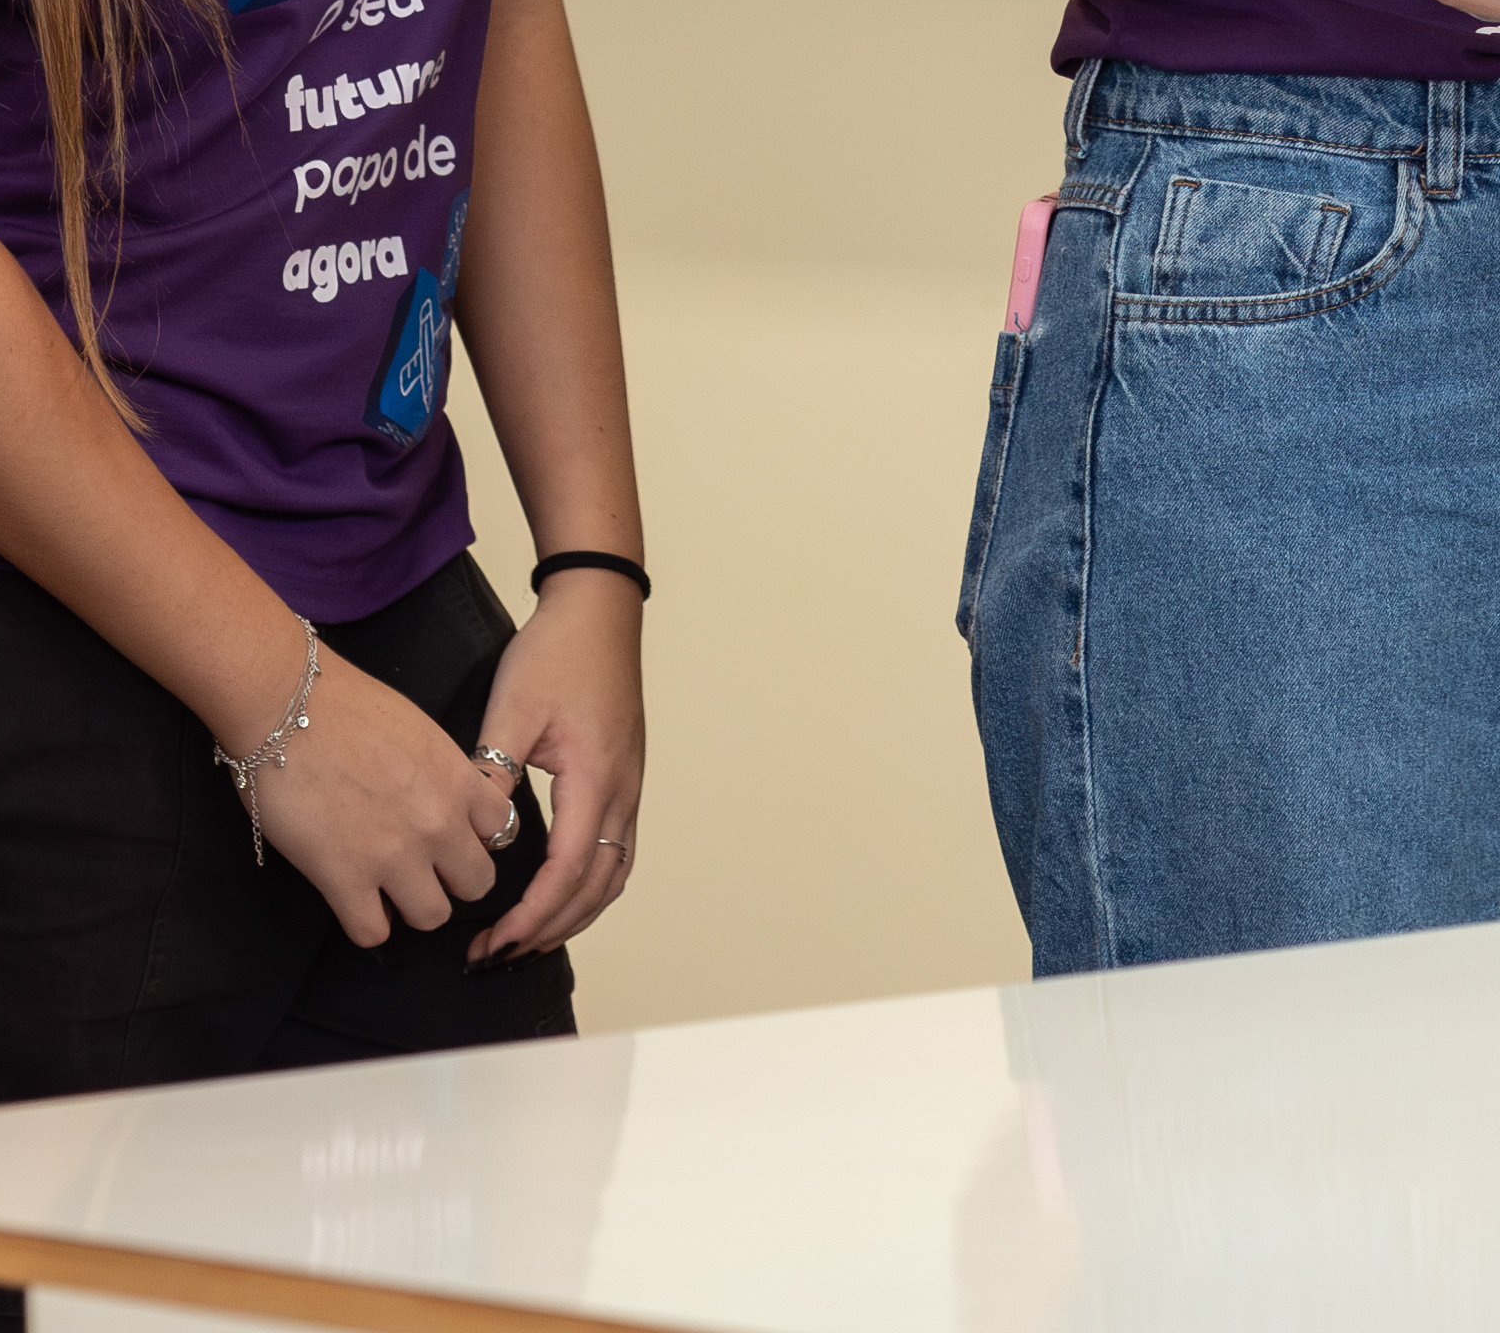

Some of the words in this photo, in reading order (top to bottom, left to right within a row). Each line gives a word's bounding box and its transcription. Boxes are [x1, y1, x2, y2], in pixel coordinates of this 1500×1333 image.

[293, 146, 398, 214] papo
[404, 124, 456, 181] de
[283, 235, 408, 303] agora
